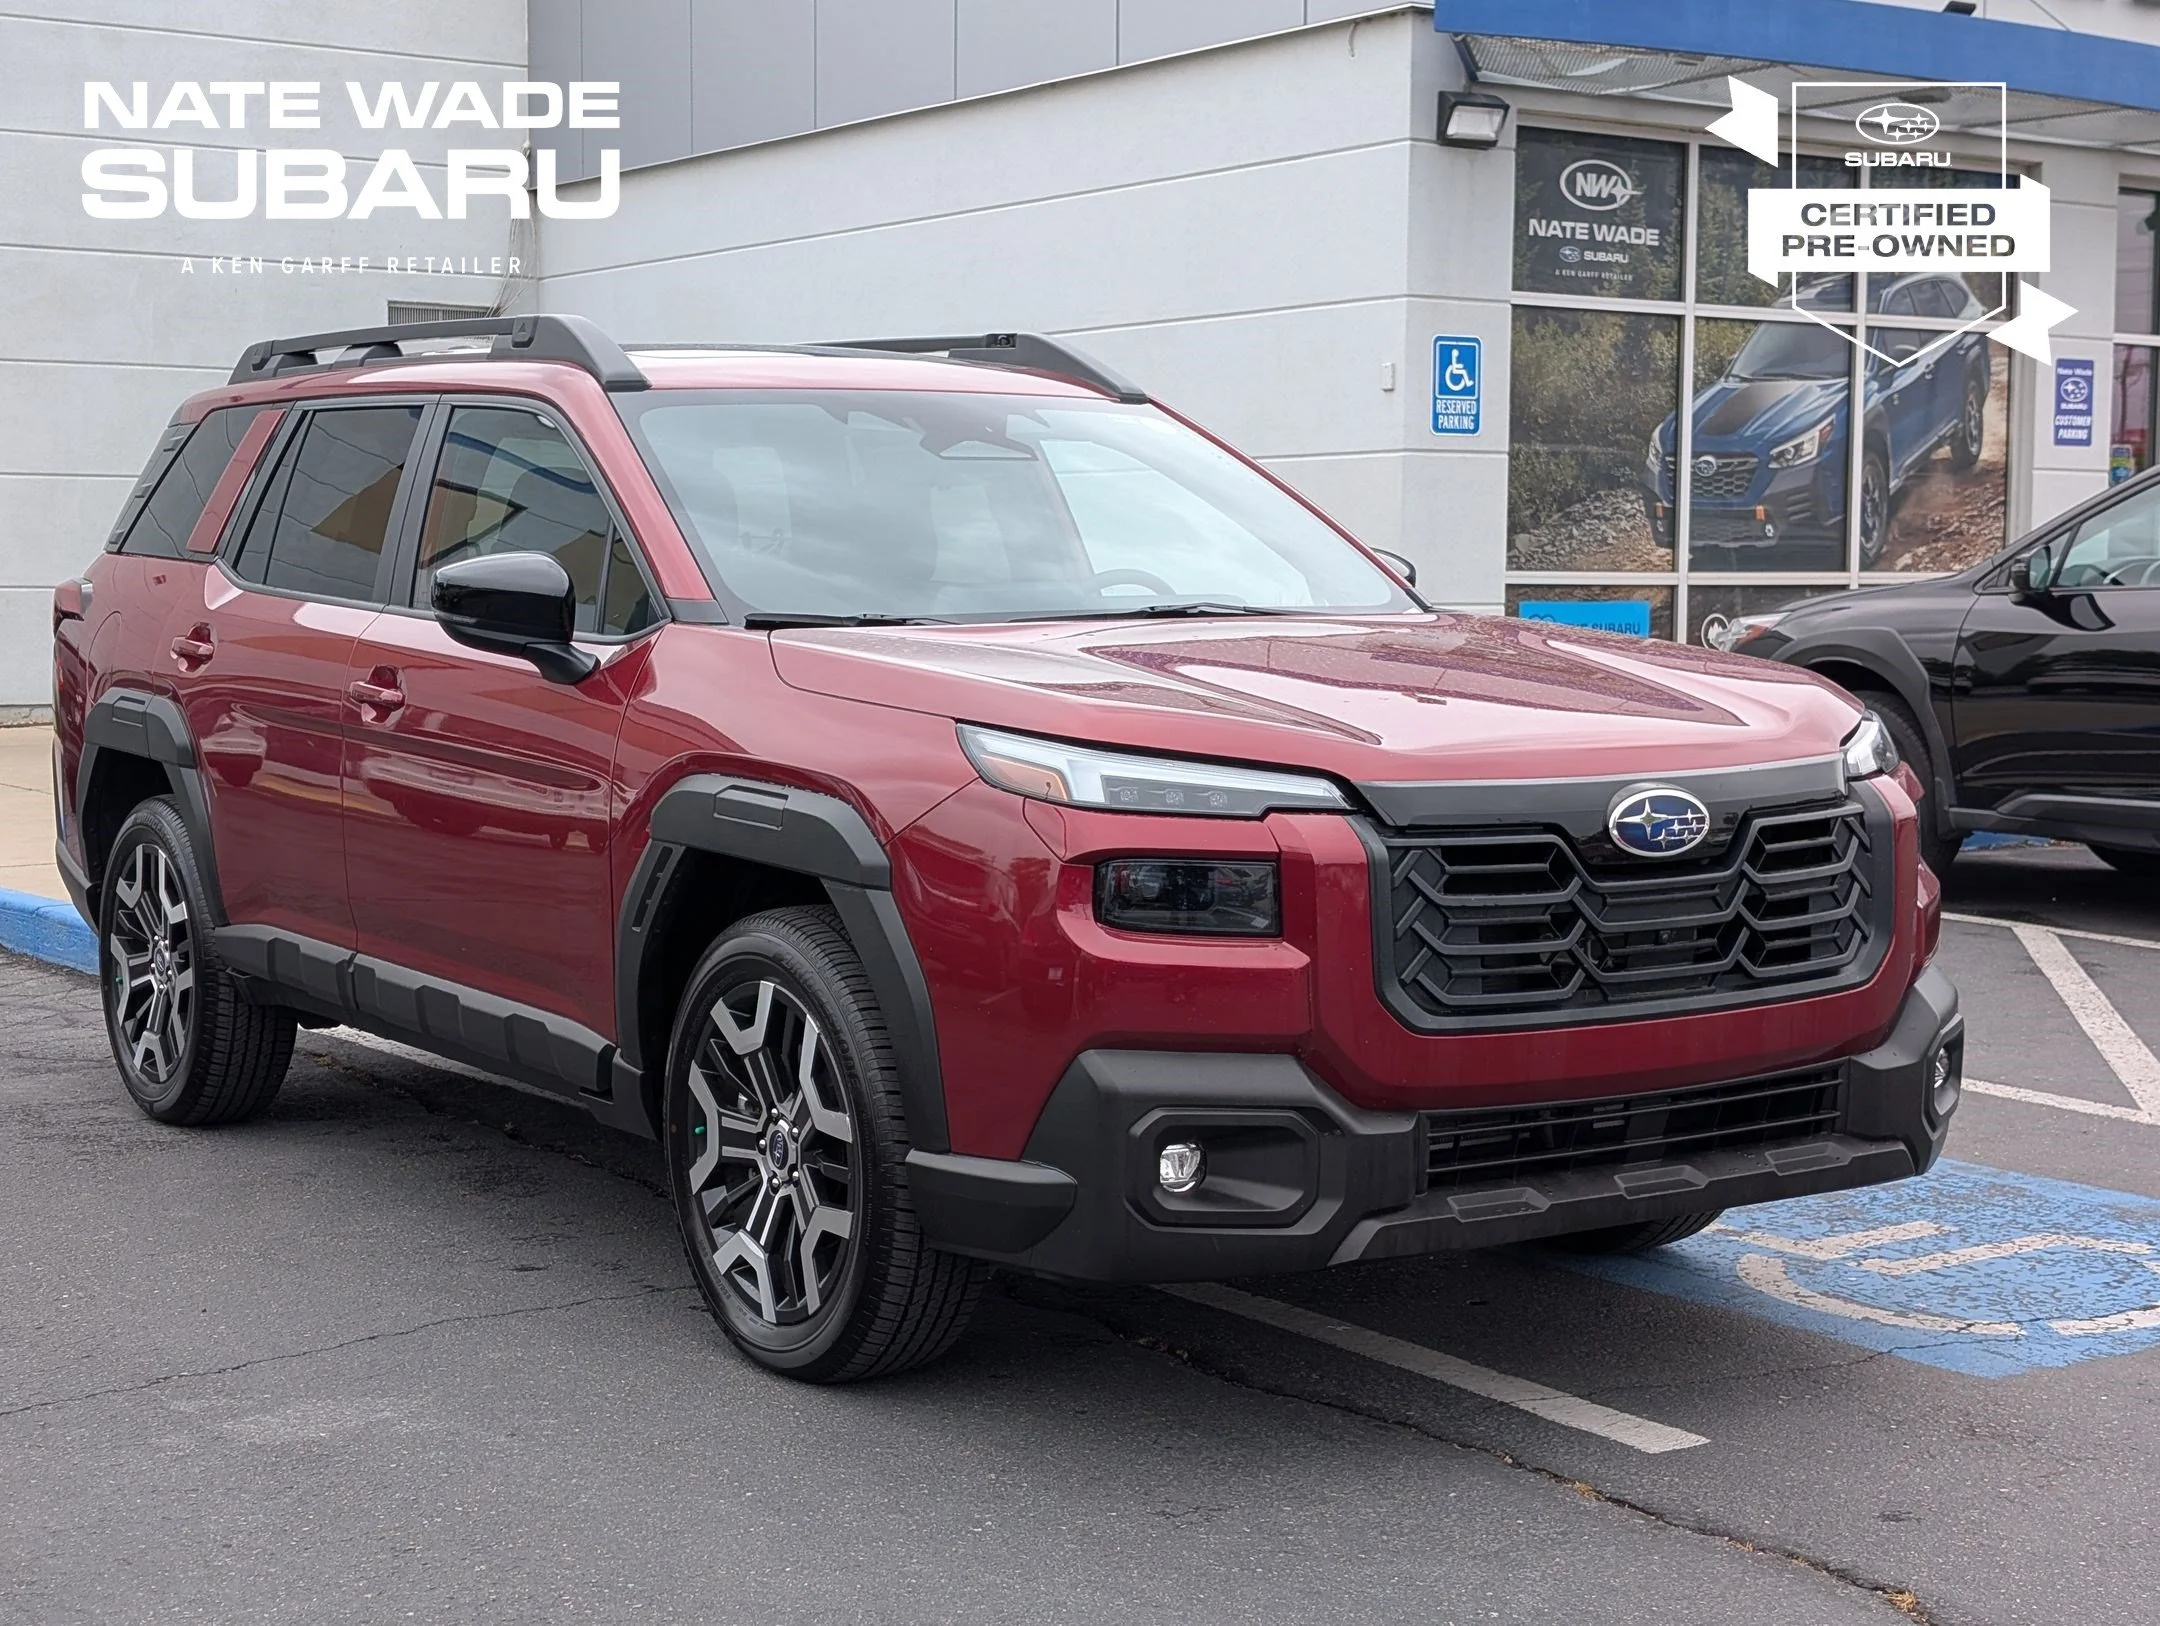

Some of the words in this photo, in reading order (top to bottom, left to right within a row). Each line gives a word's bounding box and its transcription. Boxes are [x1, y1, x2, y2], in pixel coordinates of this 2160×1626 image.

[1528, 218, 1590, 240] NATE
[1593, 223, 1660, 246] WADE
[1583, 251, 1629, 264] SUBARU
[1436, 400, 1477, 414] RESERVED
[1438, 415, 1474, 430] PARKING
[2054, 415, 2092, 427] CUSTOMER
[2057, 428, 2089, 440] PARKING
